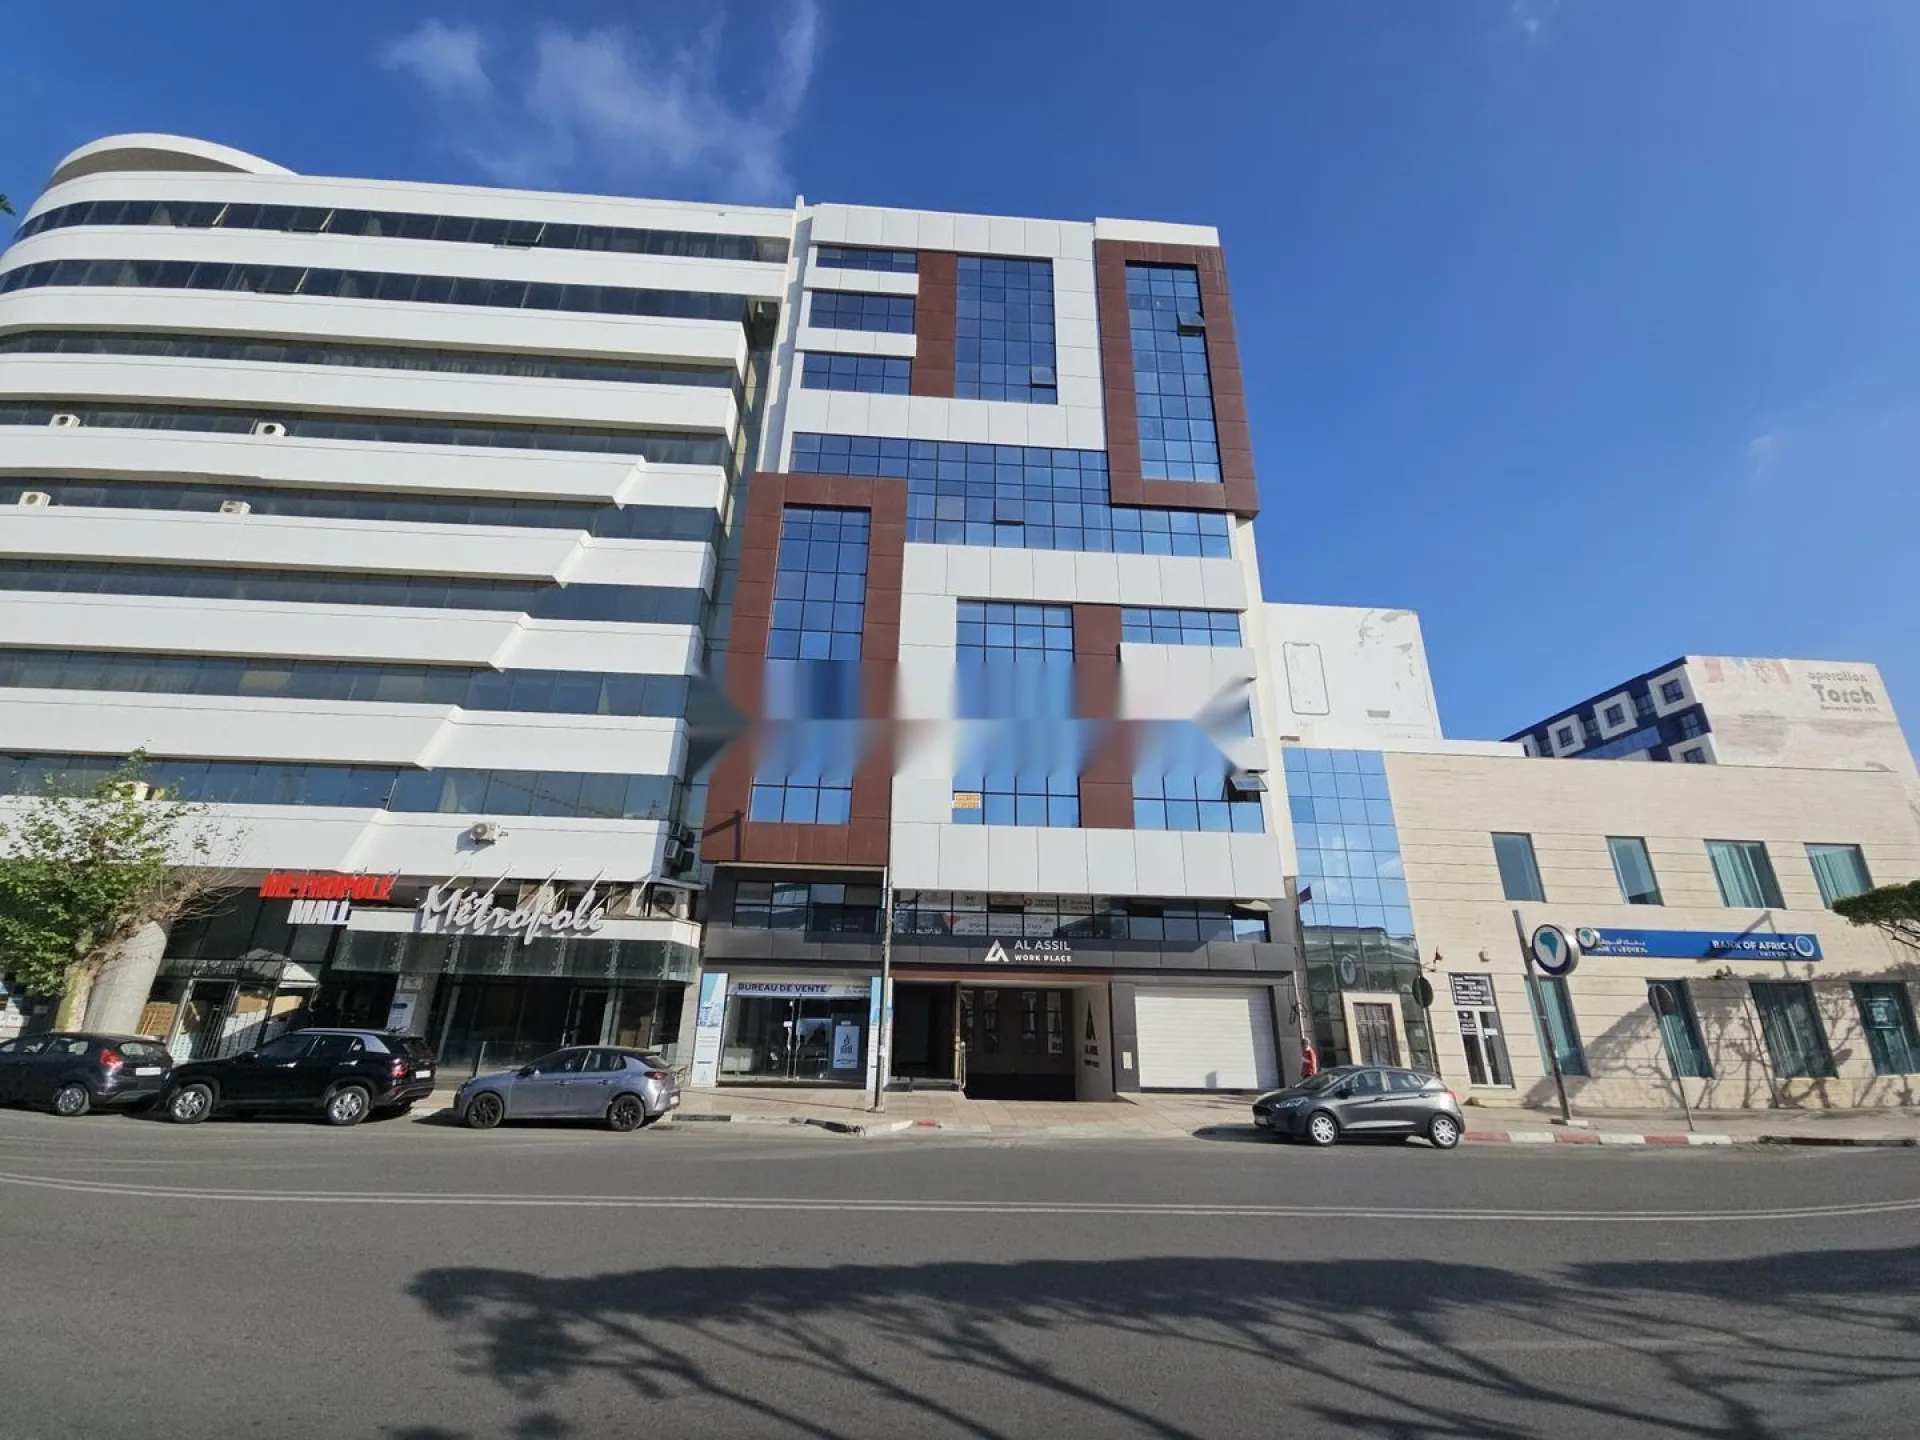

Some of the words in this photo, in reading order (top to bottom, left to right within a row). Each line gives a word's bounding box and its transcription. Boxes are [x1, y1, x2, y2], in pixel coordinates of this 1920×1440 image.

[1811, 683, 1876, 704] Torch
[259, 874, 395, 899] METROPOLE
[287, 899, 350, 924] MALL
[1014, 939, 1033, 950] AL
[1035, 940, 1071, 951] ASSIL
[1711, 939, 1741, 950] BANK
[1743, 940, 1757, 950] OF
[1759, 940, 1795, 951] AFRICA
[1014, 954, 1041, 962] WORK
[1043, 954, 1072, 963] PLACE
[738, 982, 778, 992] BUREAU
[780, 983, 793, 993] DE
[795, 984, 827, 993] VENTE
